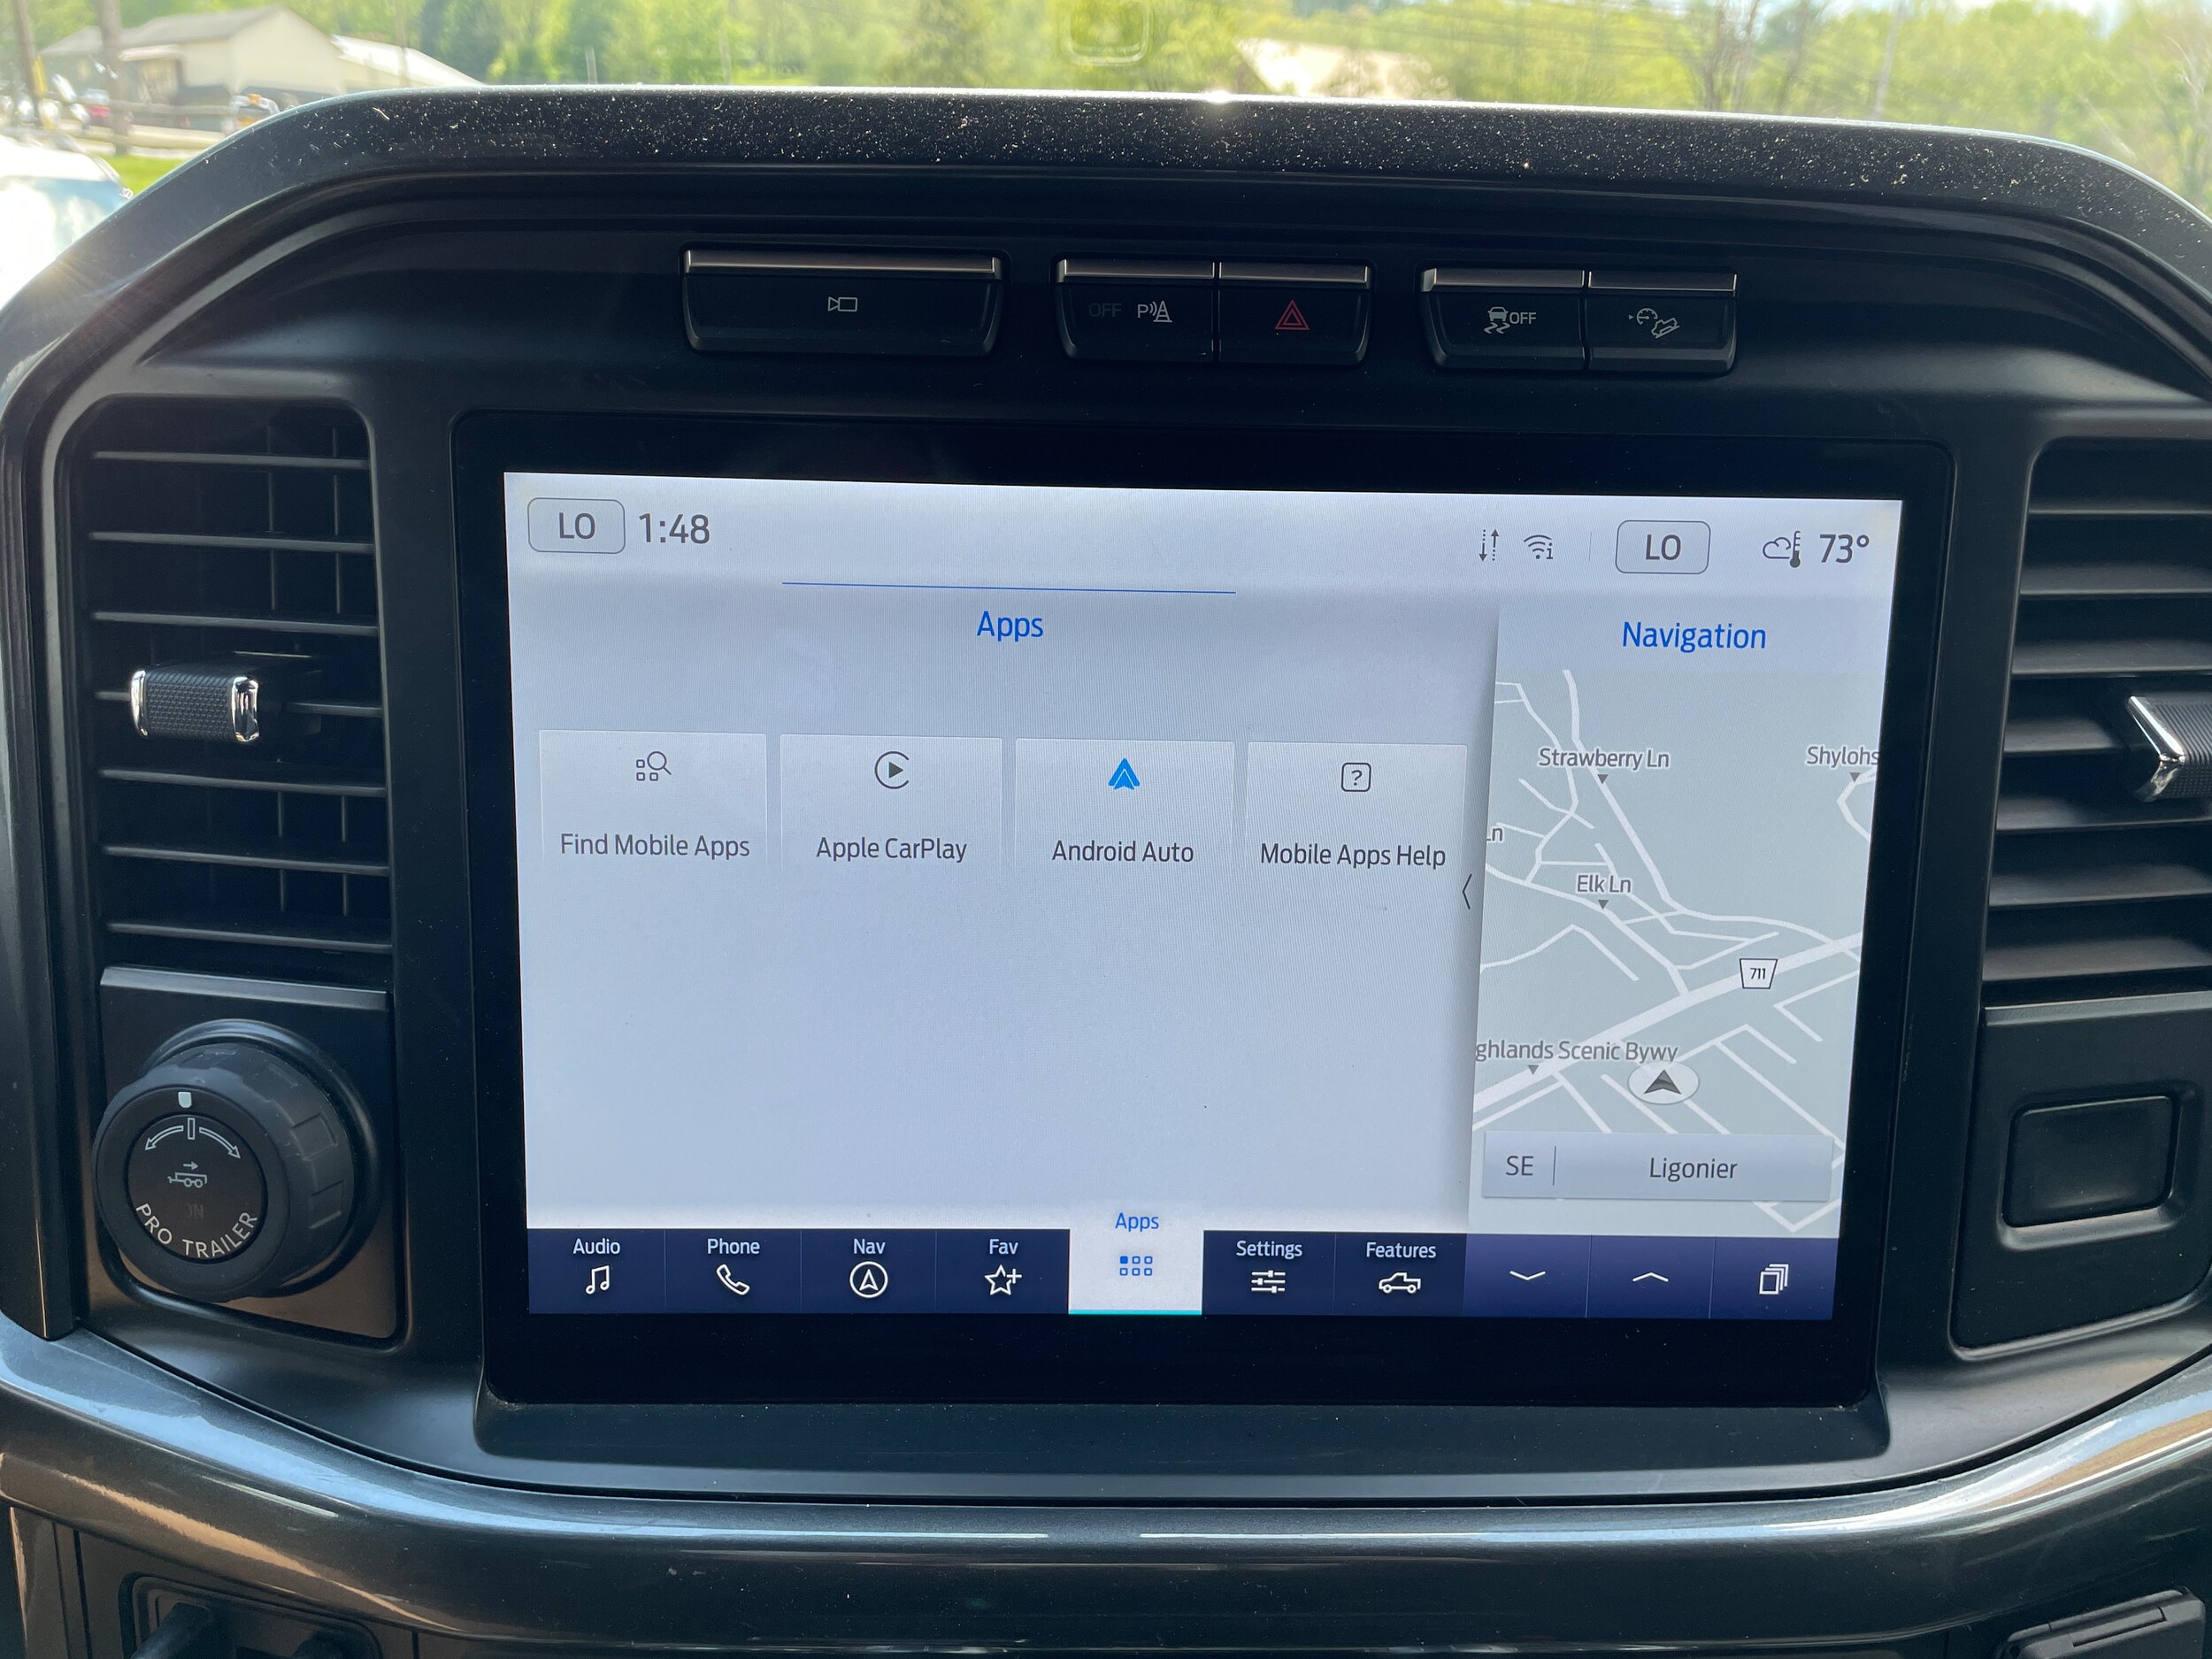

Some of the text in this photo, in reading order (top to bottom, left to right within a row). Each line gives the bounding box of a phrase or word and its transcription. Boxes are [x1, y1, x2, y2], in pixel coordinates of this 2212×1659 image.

[1088, 302, 1123, 318] OFF
[1509, 311, 1537, 325] OFF
[558, 511, 596, 540] LO
[639, 512, 710, 544] 1:48
[1645, 534, 1682, 561] LO
[1819, 534, 1870, 564] 73°
[976, 611, 1044, 642] Apps
[1622, 621, 1767, 654] Navigation
[1538, 748, 1670, 771] Strawberry Ln
[1807, 746, 1879, 768] Shylohs
[1486, 827, 1503, 841] n
[560, 833, 750, 861] Find Mobile Apps
[816, 836, 967, 863] Apple CarPlay
[1051, 840, 1194, 864] Android Auto
[1260, 842, 1447, 869] Mobile Apps Help
[1577, 874, 1632, 894] Elk Ln
[1749, 967, 1766, 980] 711
[1475, 1039, 1678, 1064] ghlands Scenic Bywy
[1505, 1156, 1534, 1177] SE
[1649, 1157, 1738, 1183] Ligonier
[135, 1203, 257, 1258] PRO TRAILER
[1115, 1212, 1160, 1232] Apps
[572, 1239, 621, 1256] Audio
[707, 1239, 761, 1256] Phone
[853, 1240, 887, 1256] Nav
[988, 1239, 1019, 1256] Fav
[1236, 1240, 1302, 1261] Settings
[1365, 1241, 1437, 1259] Features
